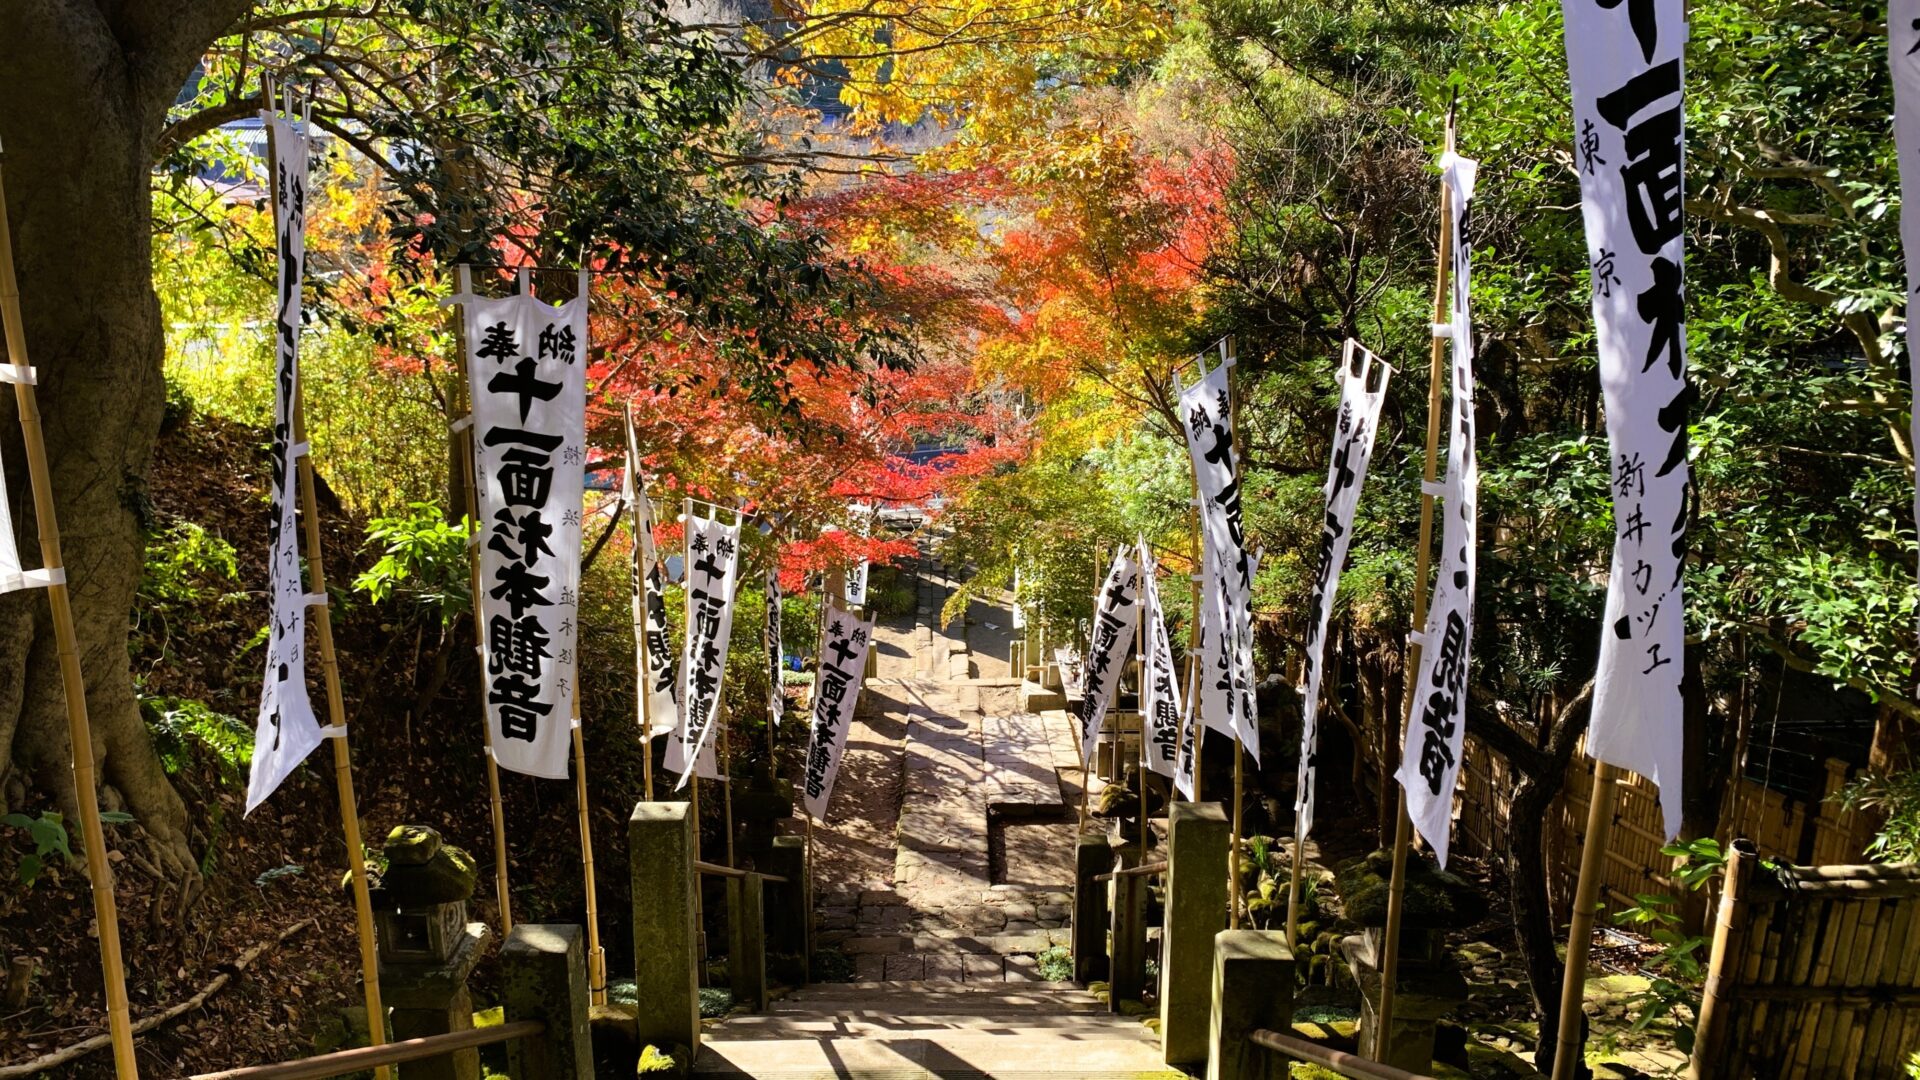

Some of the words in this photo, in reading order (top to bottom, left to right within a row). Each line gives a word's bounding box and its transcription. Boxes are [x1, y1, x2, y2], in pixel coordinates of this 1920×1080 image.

[1579, 118, 1621, 298] 東京
[1613, 452, 1671, 675] 新井カヅエ
